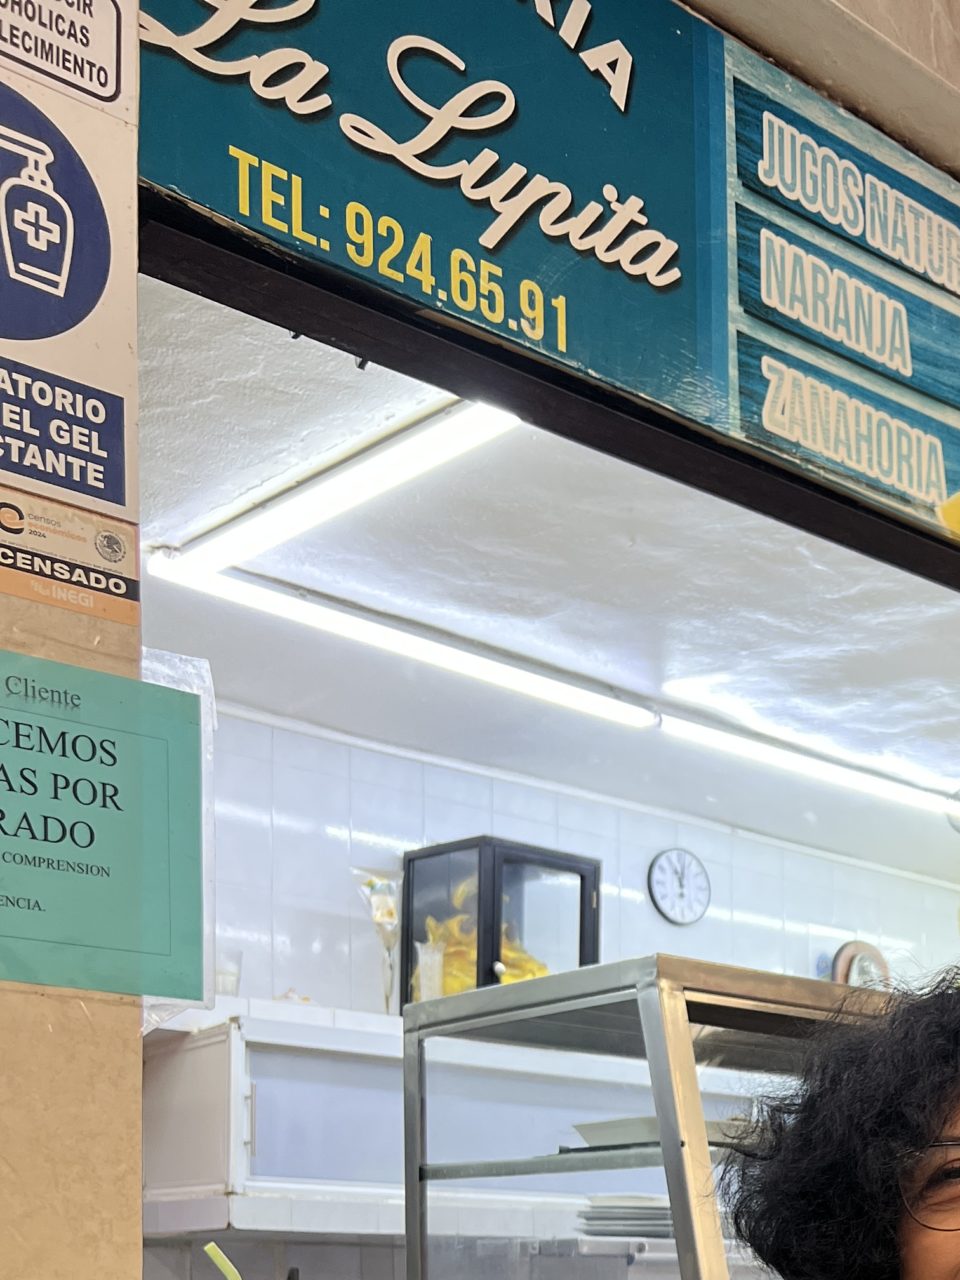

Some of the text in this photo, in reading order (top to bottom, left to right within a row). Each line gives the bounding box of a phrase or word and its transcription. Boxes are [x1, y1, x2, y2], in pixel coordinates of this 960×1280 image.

[338, 34, 682, 287] Lupita
[757, 110, 864, 237] JUGOS
[228, 144, 568, 353] TEL: 924.65.91
[759, 227, 913, 378] NARANJA
[48, 418, 108, 458] GEL
[761, 354, 949, 510] ZANAHORIA
[0, 435, 105, 489] TANTE
[28, 528, 48, 539] 2024
[0, 547, 127, 595] CENSADO
[51, 584, 94, 609] INEGI
[5, 675, 83, 709] Cliente
[50, 773, 125, 812] POR
[2, 850, 111, 878] COMPRENSION
